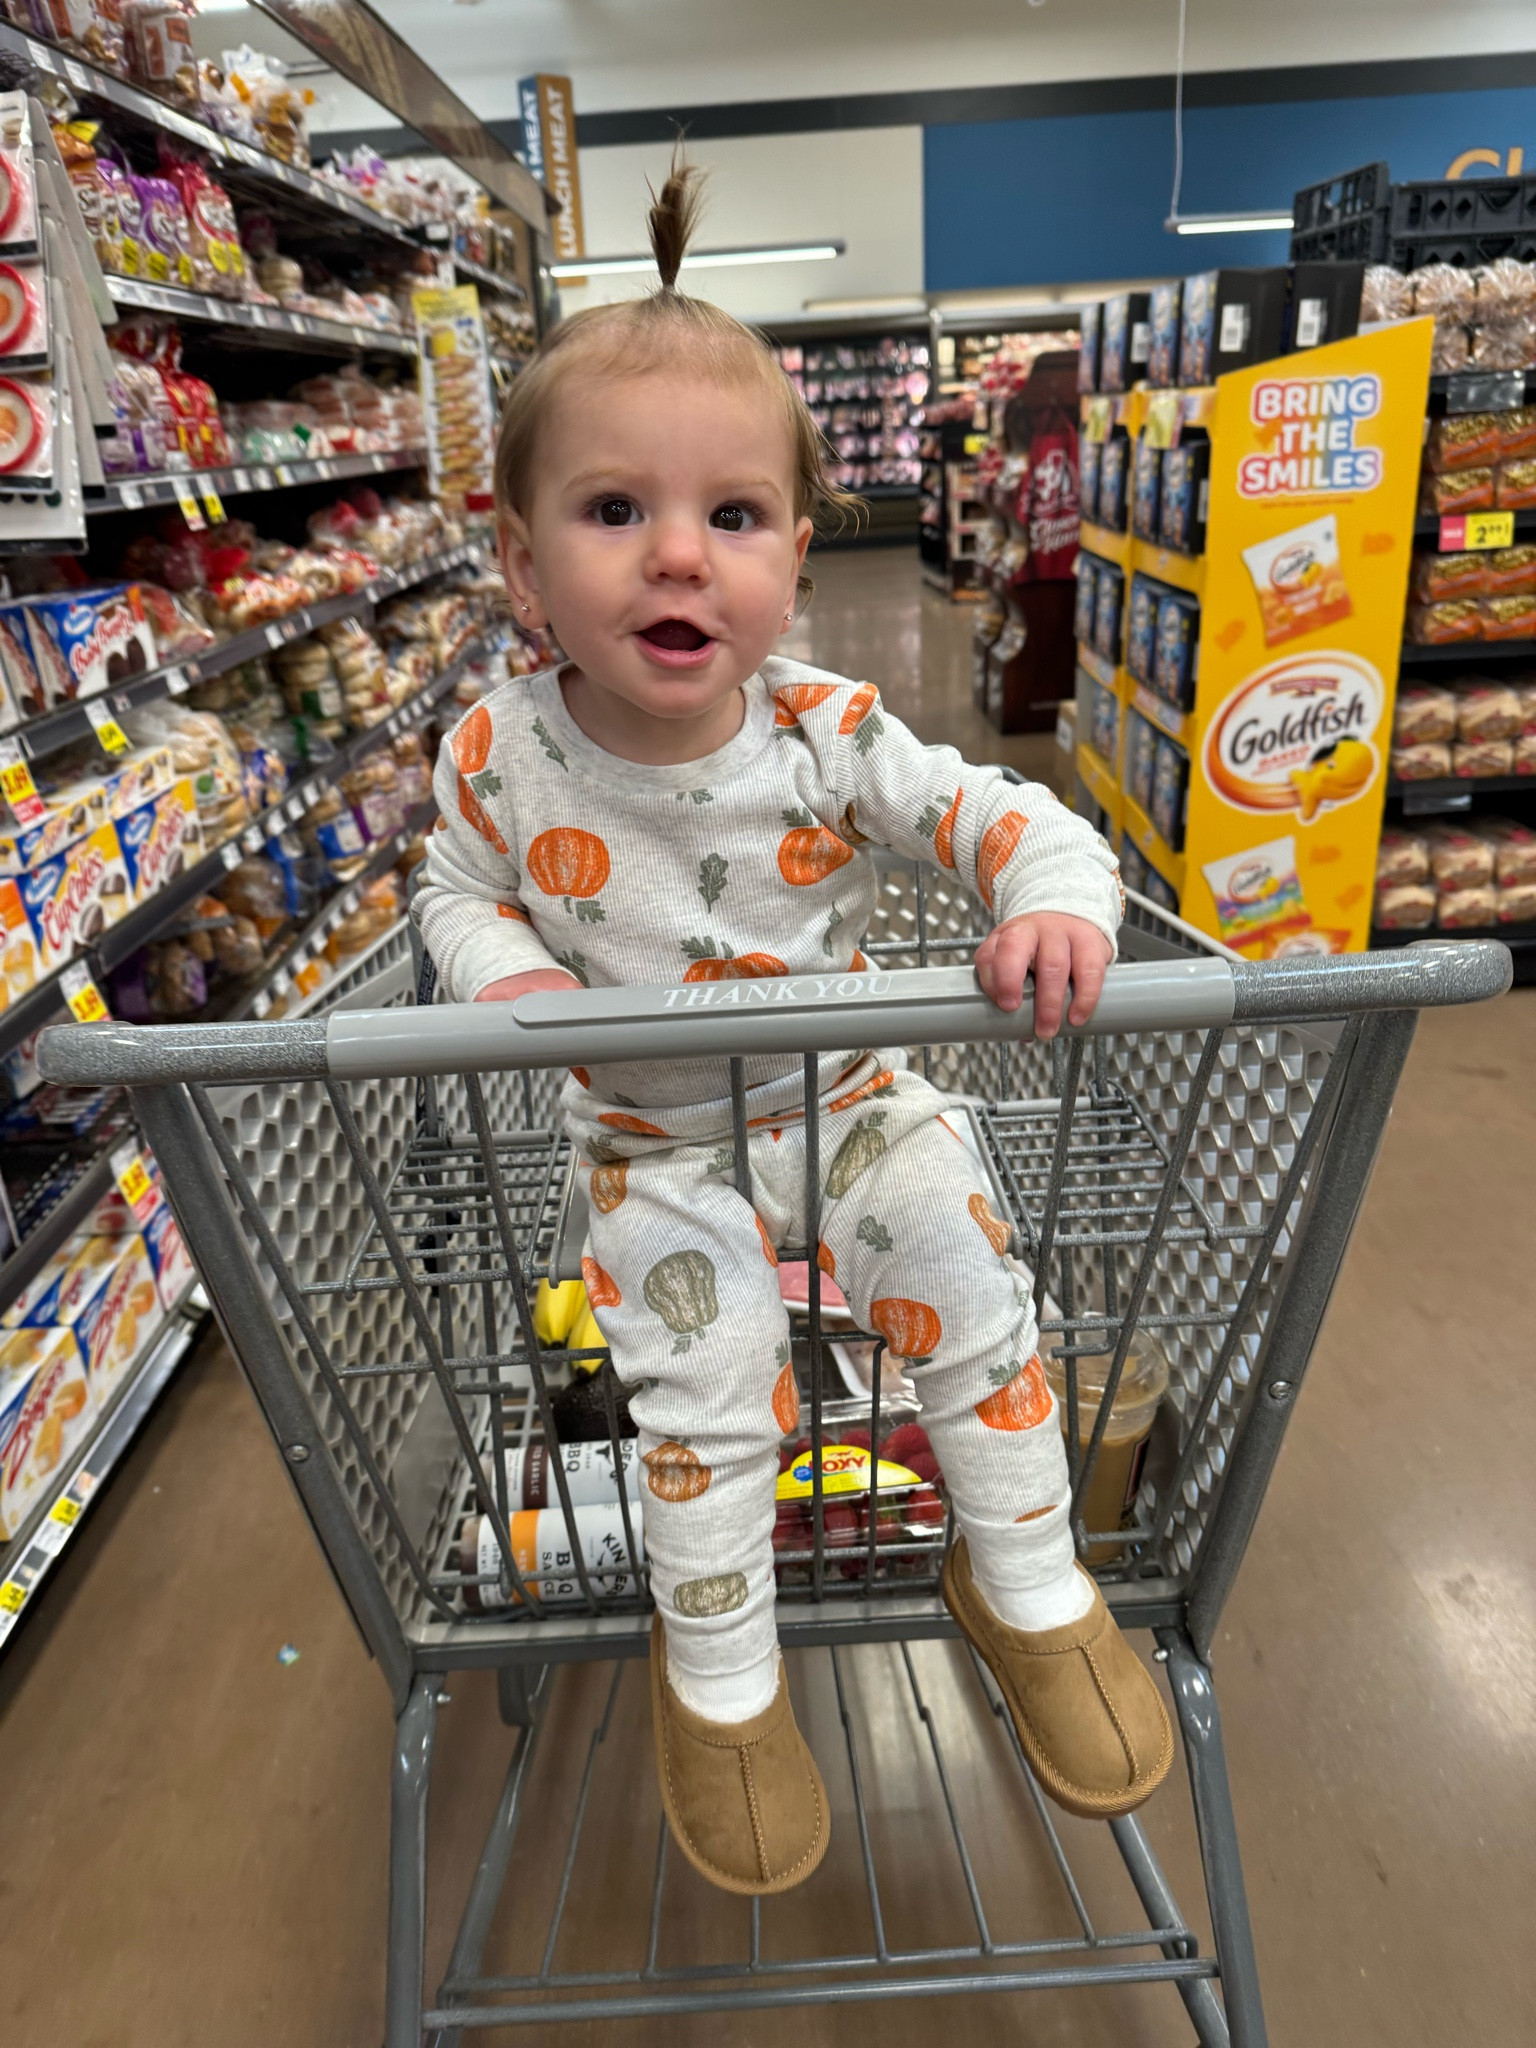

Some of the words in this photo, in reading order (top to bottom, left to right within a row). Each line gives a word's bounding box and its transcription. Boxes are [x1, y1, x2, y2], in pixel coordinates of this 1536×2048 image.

[547, 87, 570, 163] MEAT
[554, 168, 577, 258] LUNCH
[1257, 381, 1376, 419] BRING
[1281, 419, 1350, 453] THE
[1244, 453, 1377, 491] SMILES
[1230, 693, 1366, 765] Goldfish
[663, 981, 802, 1009] THANK
[813, 976, 894, 998] YOU
[566, 1442, 582, 1473] BBQ
[542, 1551, 555, 1596] SACE
[556, 1551, 573, 1594] BQ
